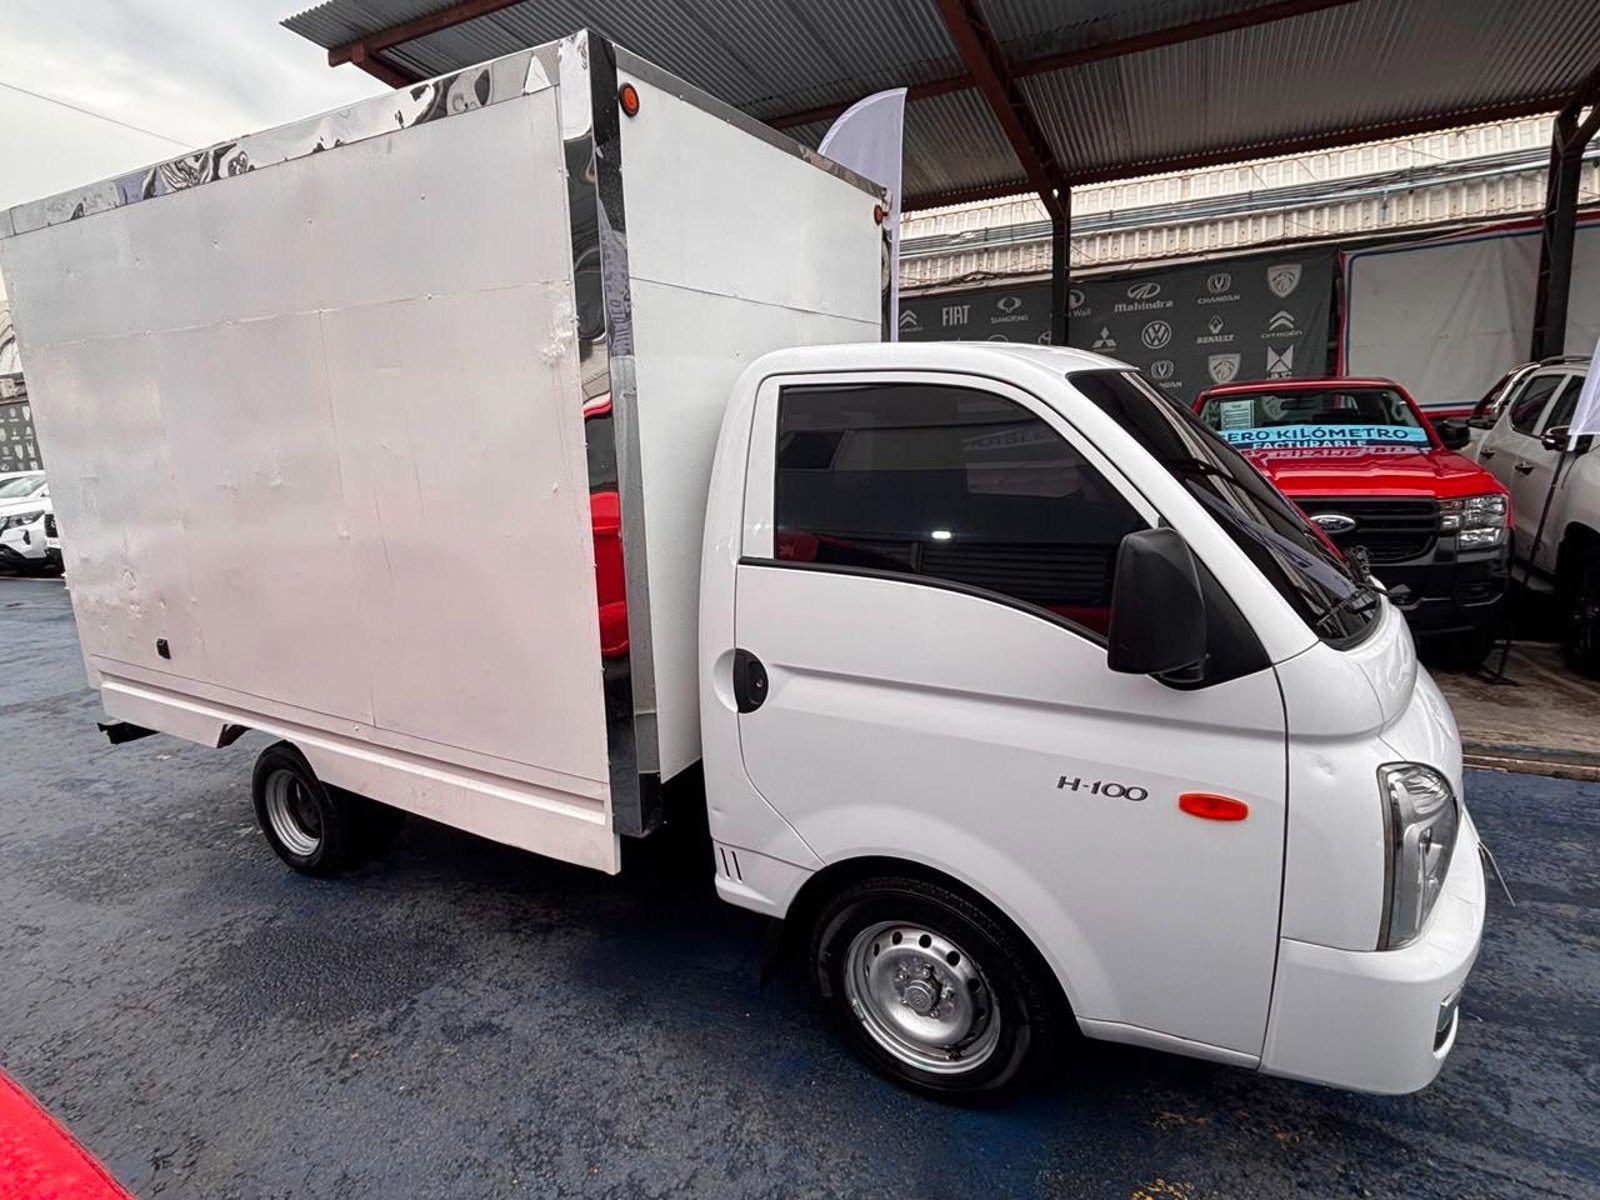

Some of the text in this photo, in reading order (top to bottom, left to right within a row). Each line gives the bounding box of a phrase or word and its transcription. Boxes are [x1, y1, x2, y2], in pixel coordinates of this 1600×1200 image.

[1114, 300, 1174, 313] Mahindra
[942, 305, 971, 326] FIAT
[1196, 334, 1234, 345] RENAULT
[1224, 427, 1409, 443] ERO KILÓMETRO
[1253, 440, 1368, 449] FACTURABLE
[1056, 775, 1149, 802] H-100
